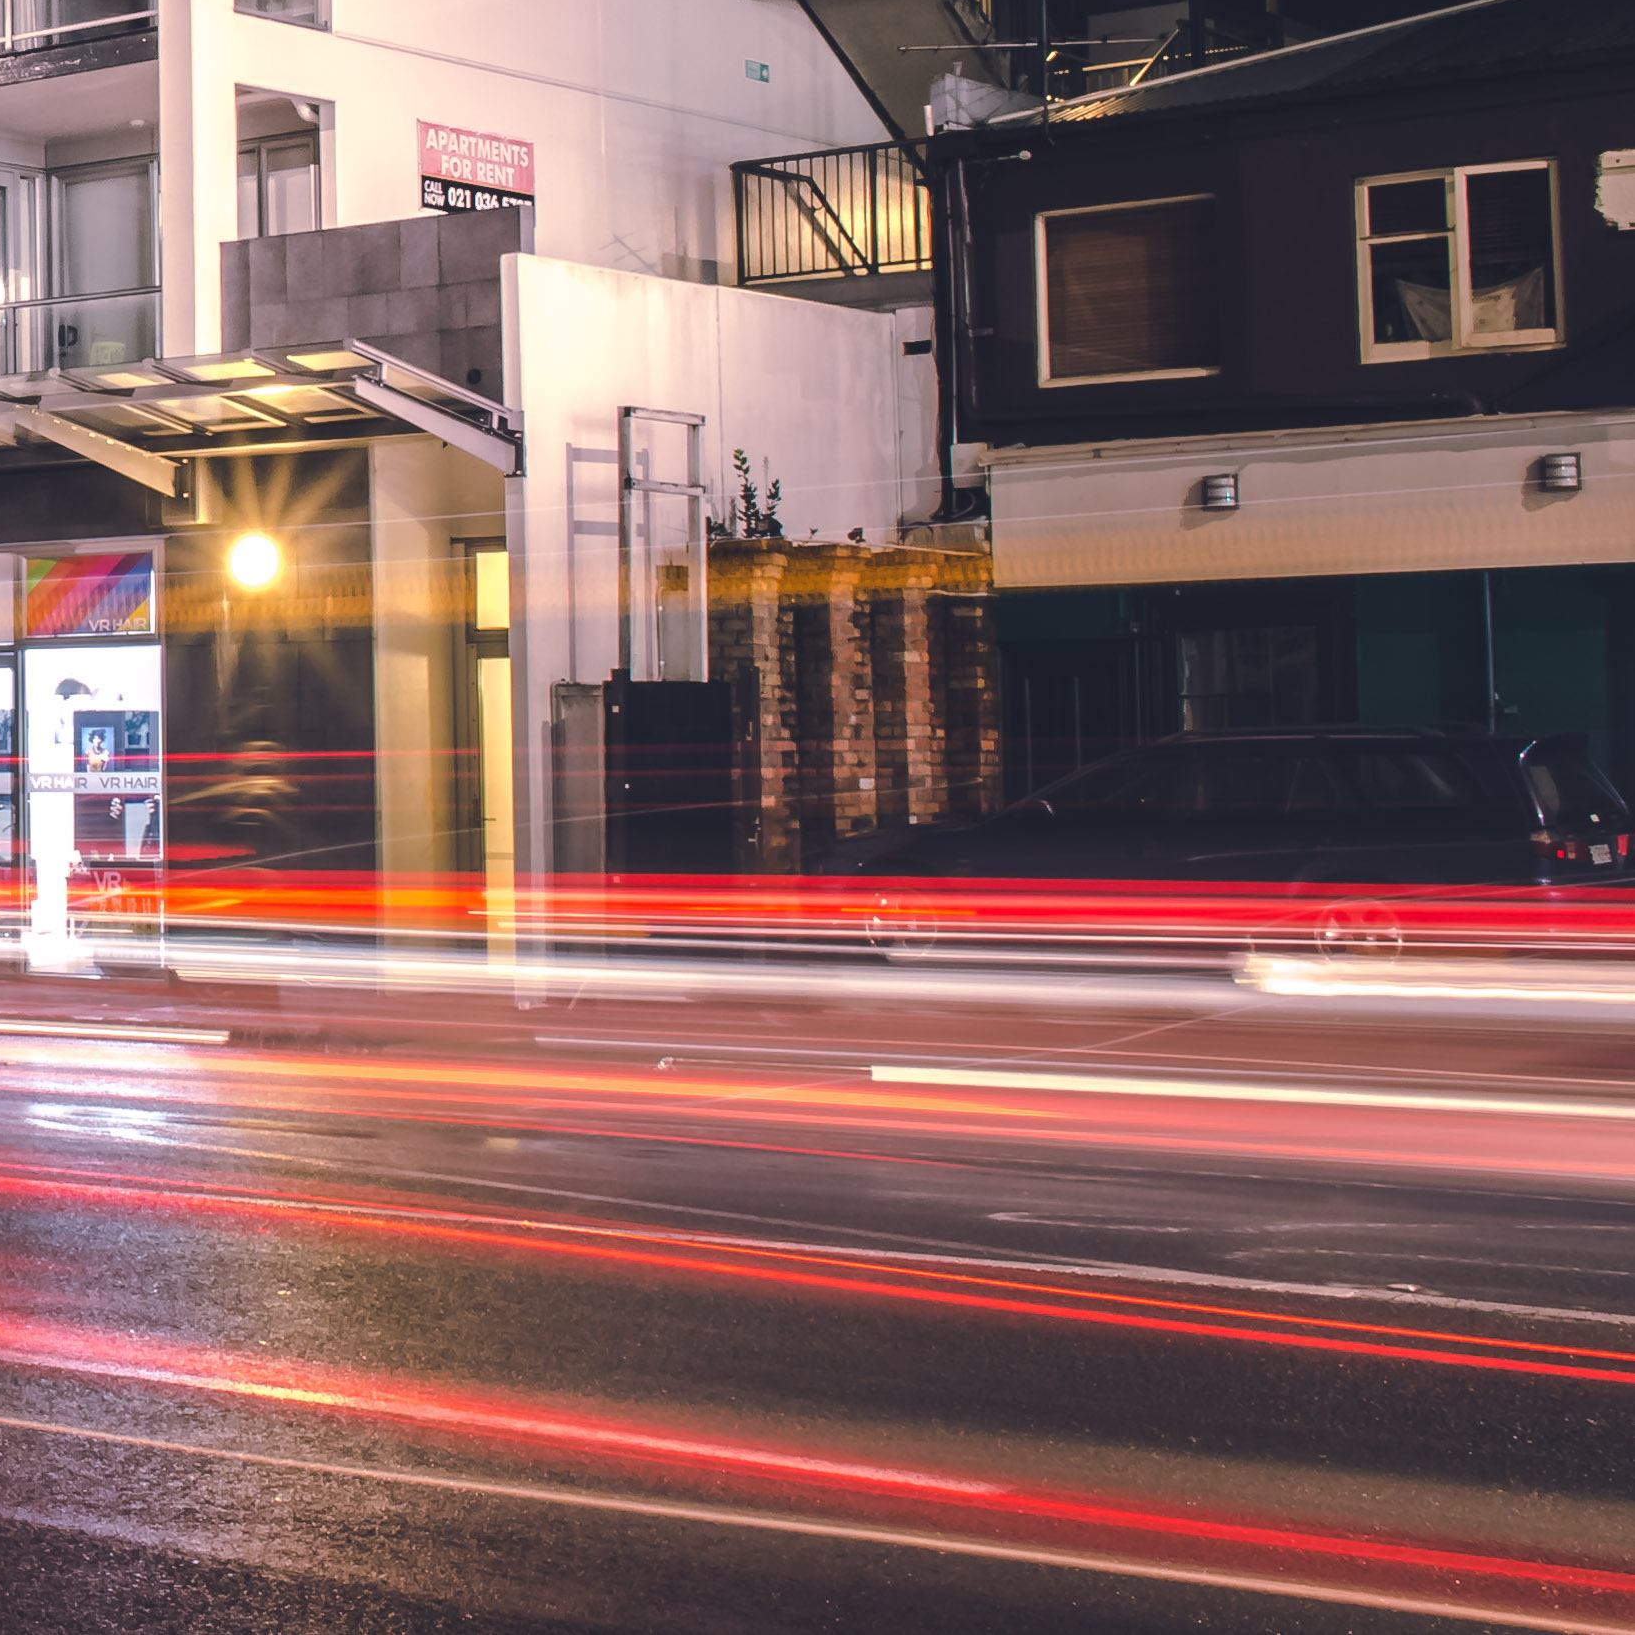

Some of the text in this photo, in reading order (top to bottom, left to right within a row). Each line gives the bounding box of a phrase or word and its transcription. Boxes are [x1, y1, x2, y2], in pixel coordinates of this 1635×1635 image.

[425, 128, 529, 168] APARTMENTS
[441, 154, 515, 187] FOR RENT
[424, 180, 443, 195] CALL
[424, 193, 445, 207] NOW
[448, 187, 471, 209] 021
[89, 617, 147, 632] VR HAIR
[30, 775, 158, 789] VR HAIR VR HAIR
